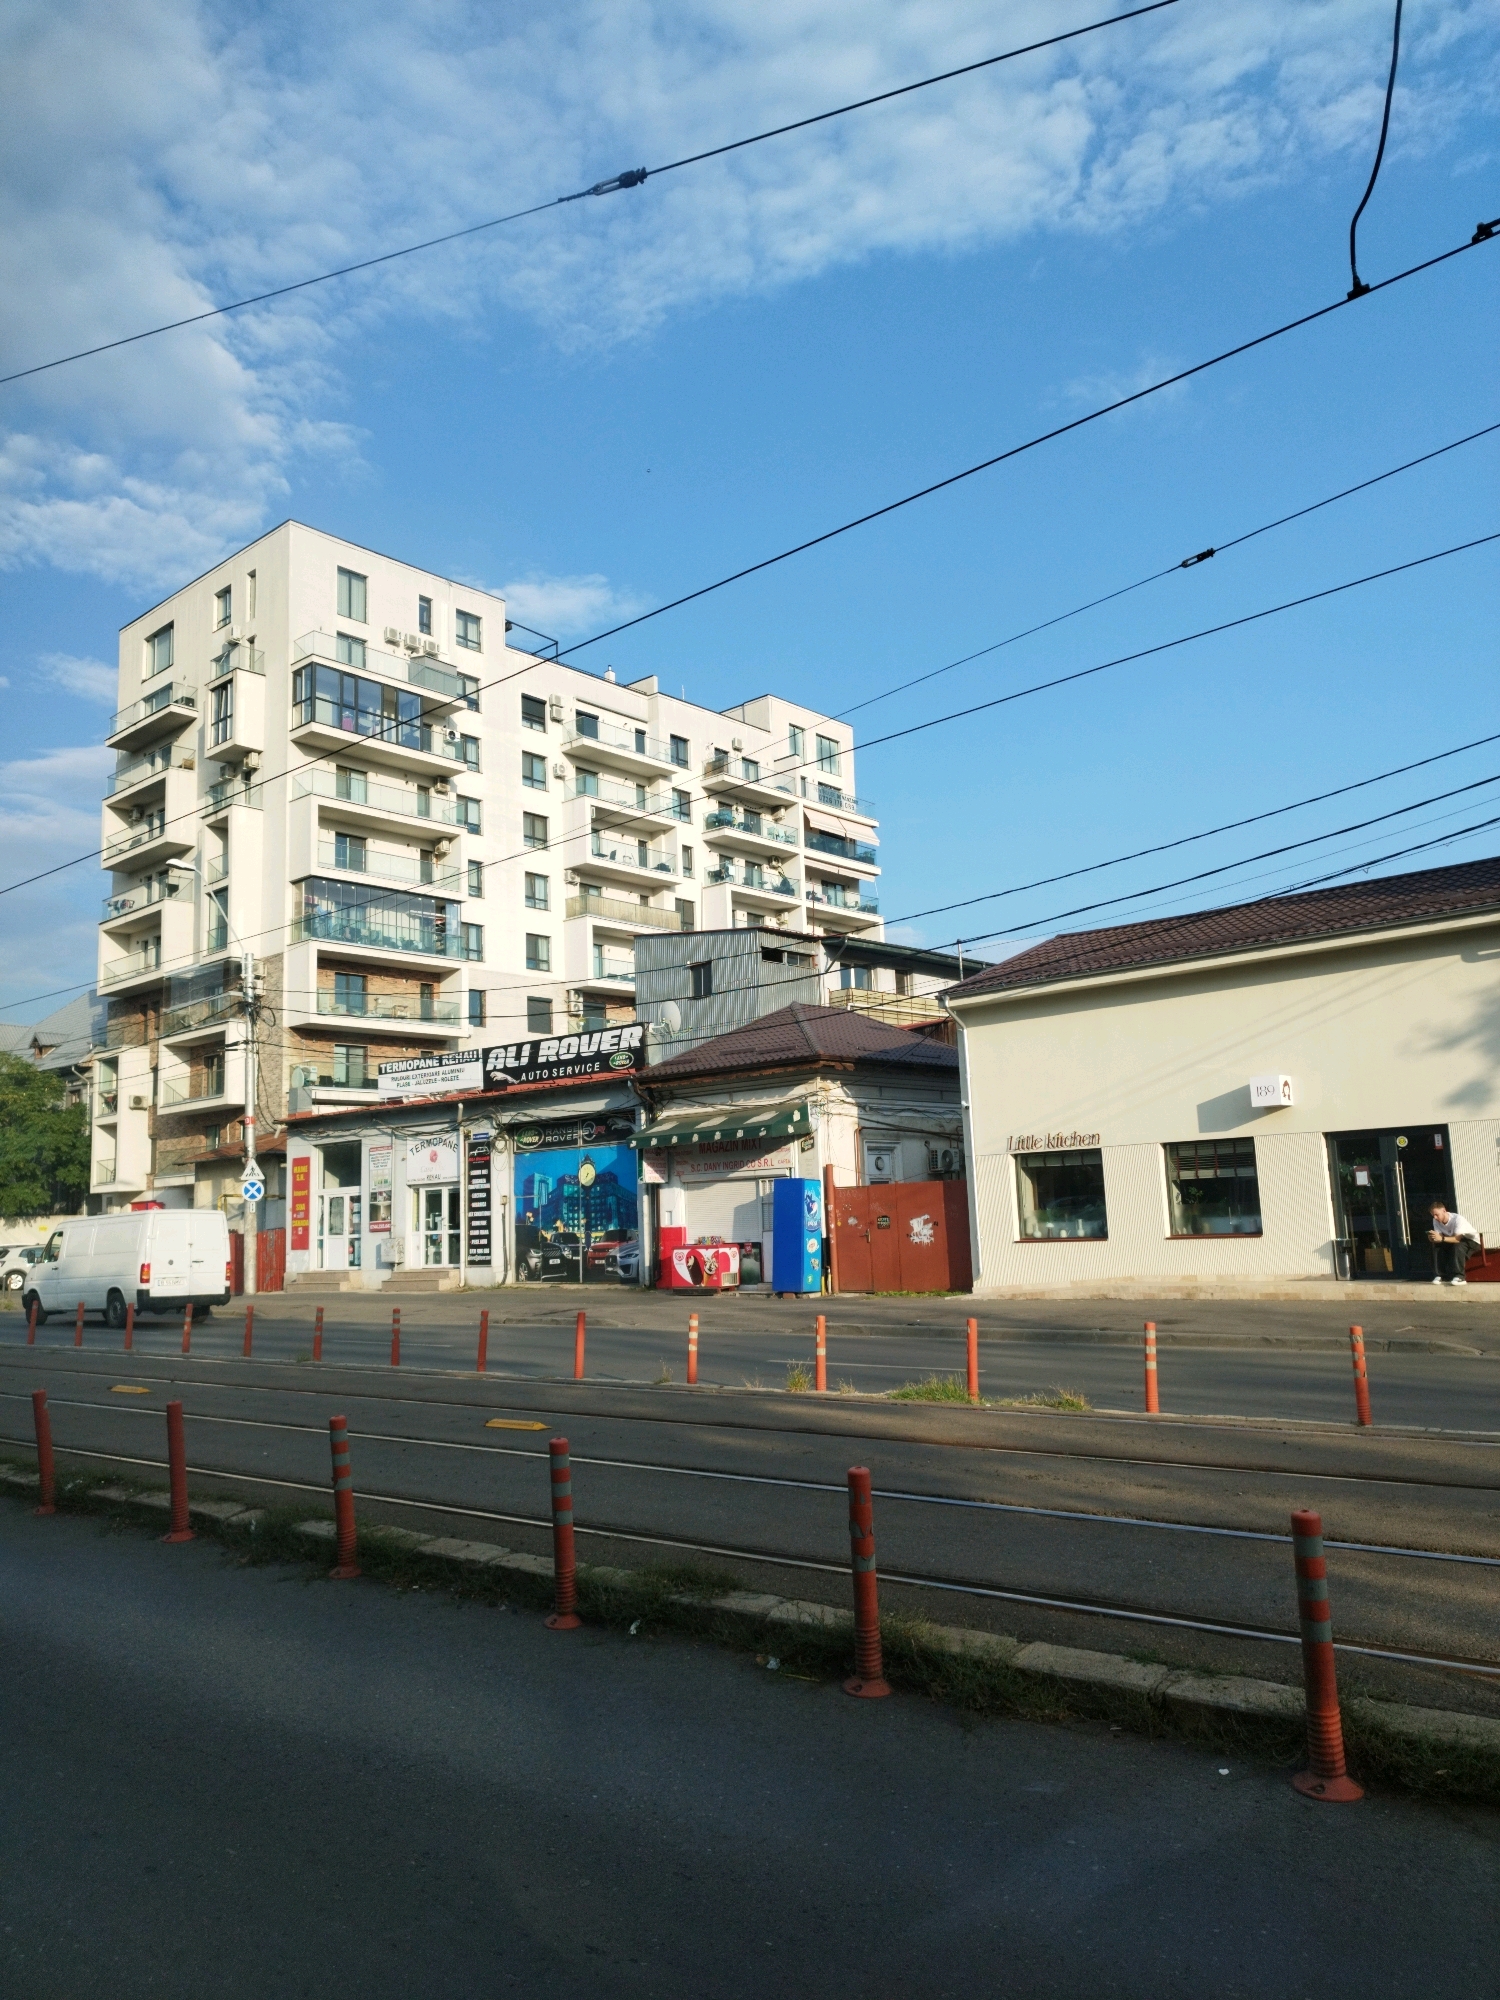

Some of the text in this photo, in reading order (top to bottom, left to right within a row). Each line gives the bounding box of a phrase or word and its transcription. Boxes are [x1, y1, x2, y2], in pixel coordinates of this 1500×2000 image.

[486, 1026, 643, 1071] ALI ROVER
[380, 1050, 477, 1074] TERMOPANE REHAU
[441, 1067, 465, 1076] ALUMINIU
[521, 1062, 601, 1082] AUTO SERVICE
[441, 1075, 459, 1083] ROLETE
[1256, 1085, 1275, 1097] 189
[545, 1126, 578, 1135] RANGE
[523, 1135, 539, 1143] ROVER
[545, 1134, 579, 1143] ROVER
[1009, 1131, 1100, 1151] Little kitchen
[410, 1137, 459, 1156] TERMOPANE
[699, 1140, 738, 1154] MAGAZIN
[704, 1162, 721, 1171] DANY
[723, 1160, 745, 1170] INGRID
[746, 1159, 756, 1168] CO
